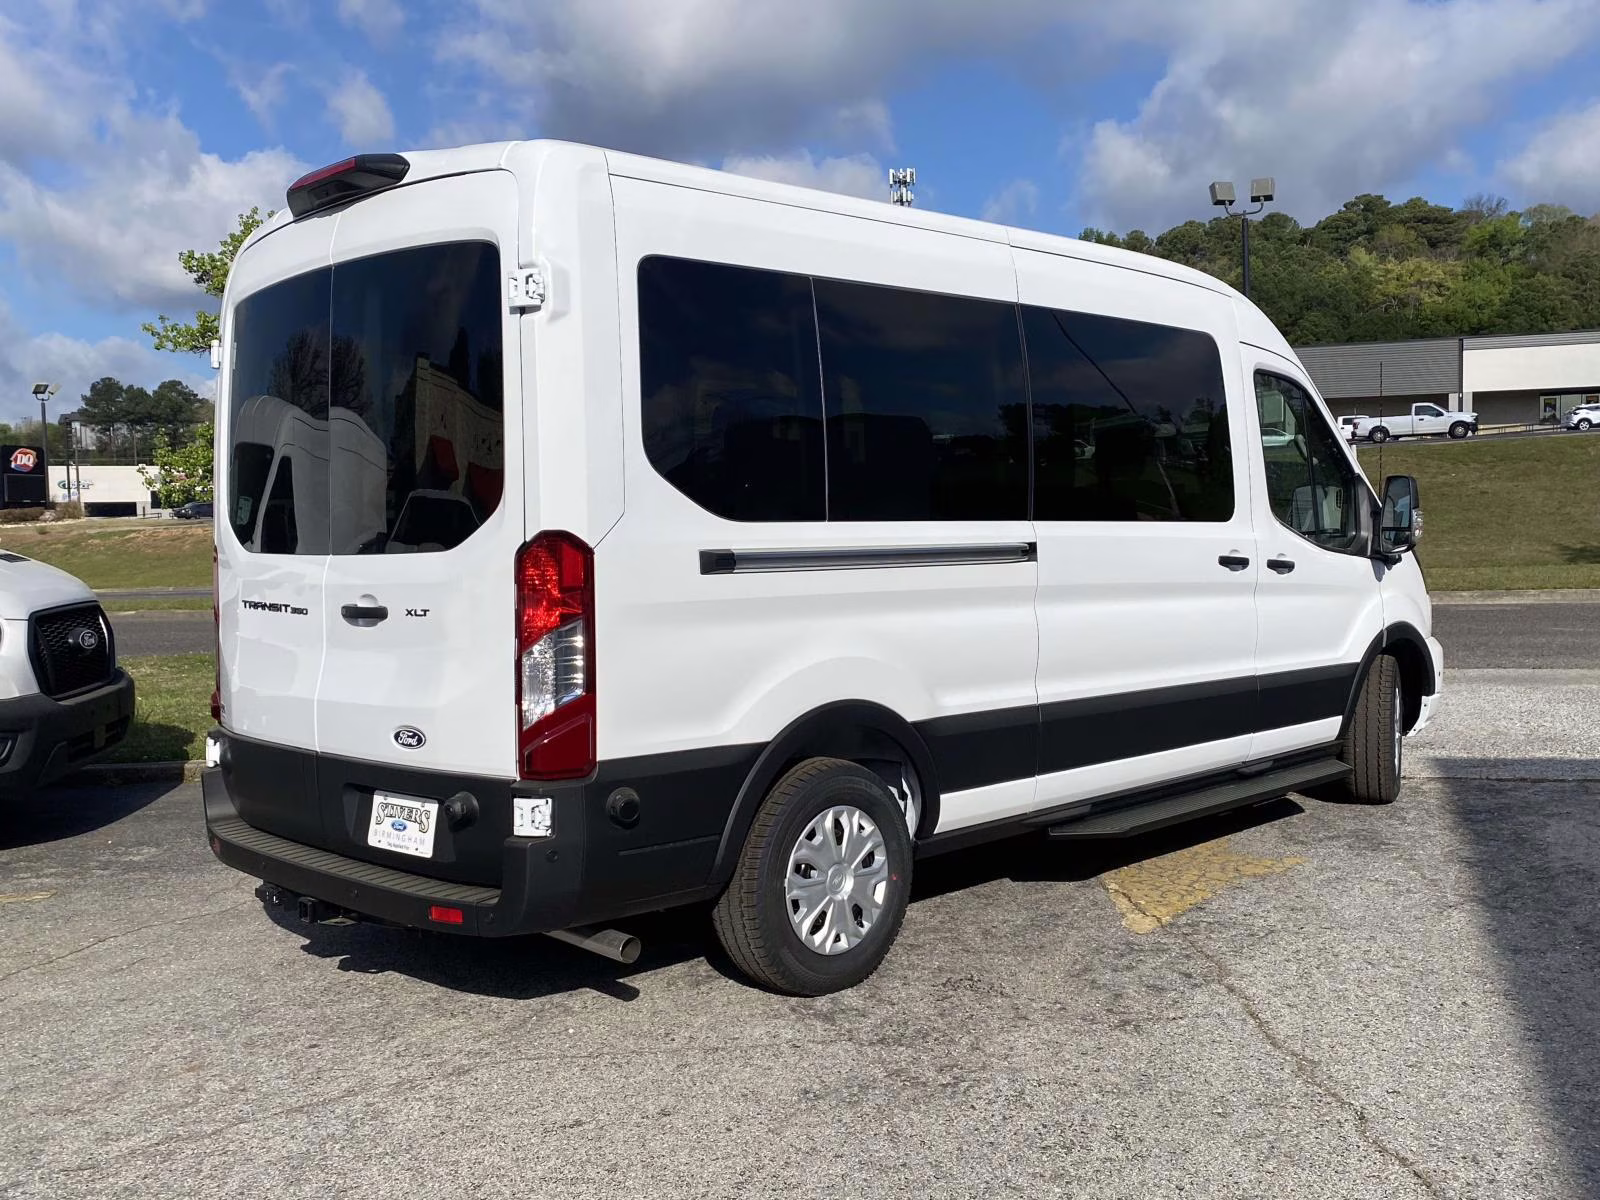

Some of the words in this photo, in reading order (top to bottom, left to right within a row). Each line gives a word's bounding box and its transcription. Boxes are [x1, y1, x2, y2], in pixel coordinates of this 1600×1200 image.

[16, 453, 34, 466] DQ
[242, 600, 290, 613] TRANSIT
[405, 608, 430, 617] XLT
[398, 730, 418, 746] Ford
[375, 802, 431, 833] STIVERS
[374, 828, 425, 847] BIRMINGHAM
